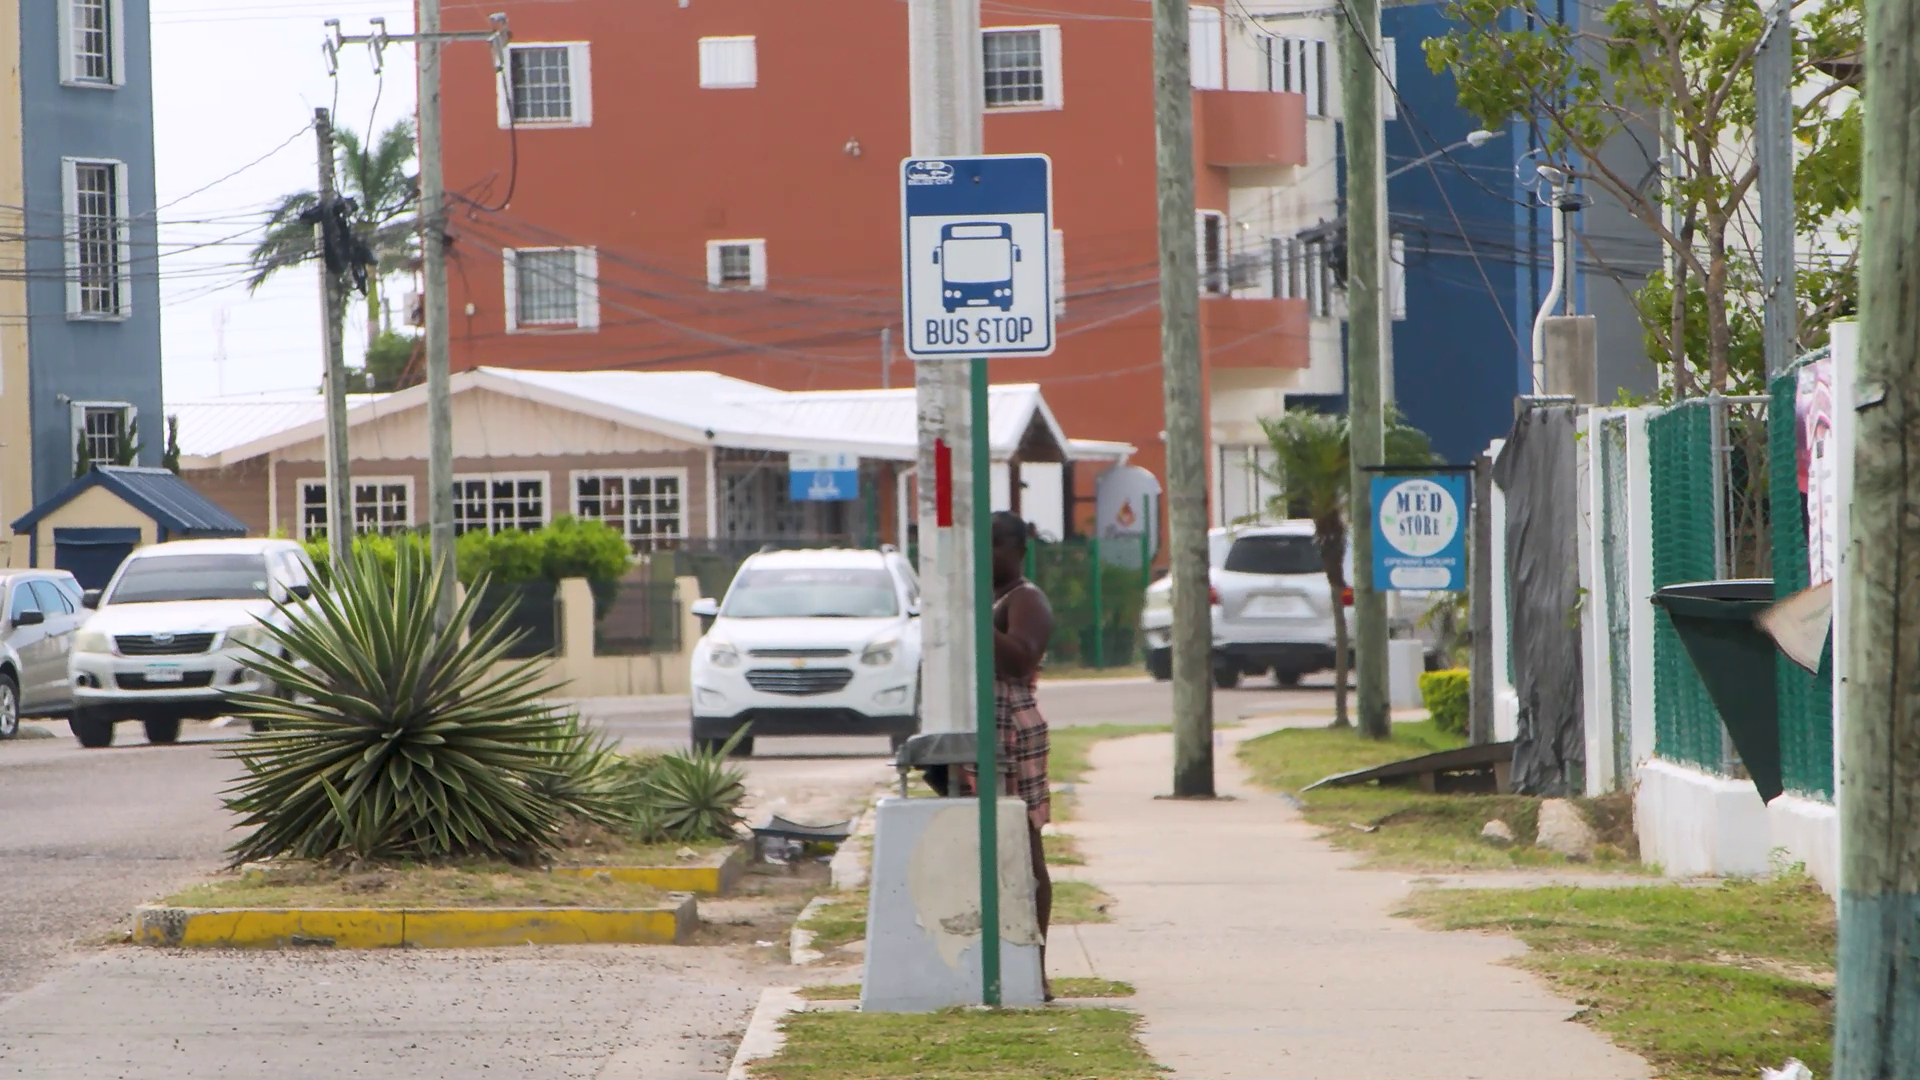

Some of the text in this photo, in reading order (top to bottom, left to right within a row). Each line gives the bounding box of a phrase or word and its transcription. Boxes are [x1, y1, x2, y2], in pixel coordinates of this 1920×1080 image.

[927, 317, 1033, 345] BUS STOP
[1397, 491, 1441, 513] MED
[1399, 514, 1439, 536] STORE
[1384, 557, 1455, 566] OPENING HOURS
